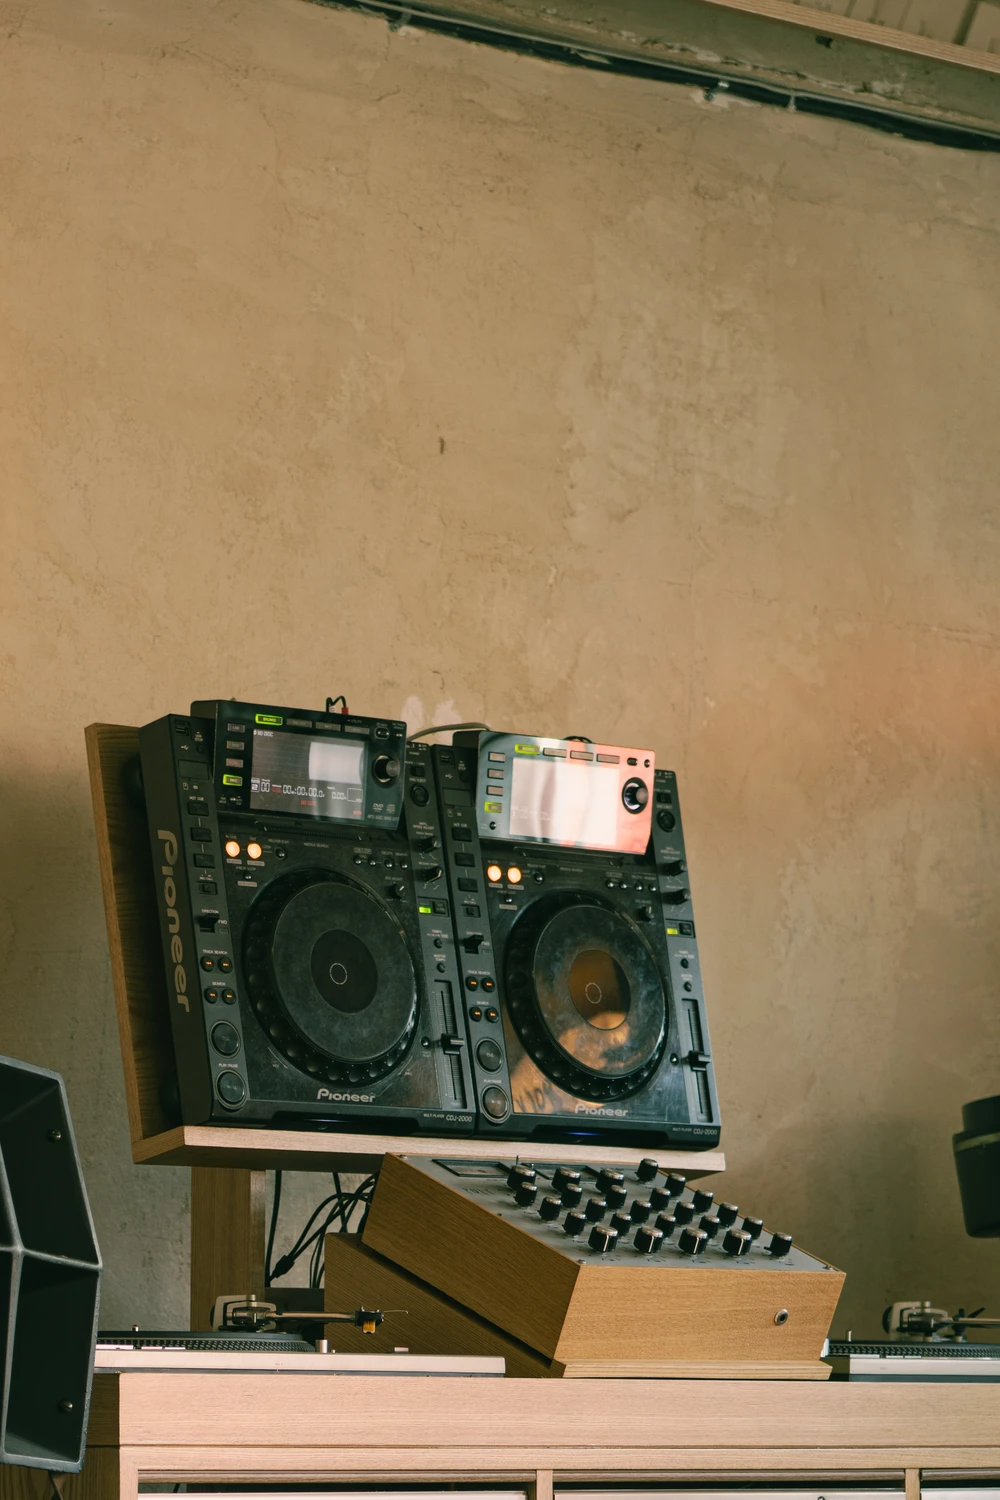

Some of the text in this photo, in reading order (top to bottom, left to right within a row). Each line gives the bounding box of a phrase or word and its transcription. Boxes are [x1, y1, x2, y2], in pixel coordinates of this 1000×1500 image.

[157, 830, 190, 1013] Pioneer
[317, 1088, 375, 1103] Pioneer
[575, 1103, 628, 1117] Pioneer
[446, 1114, 472, 1122] CDJ-2000
